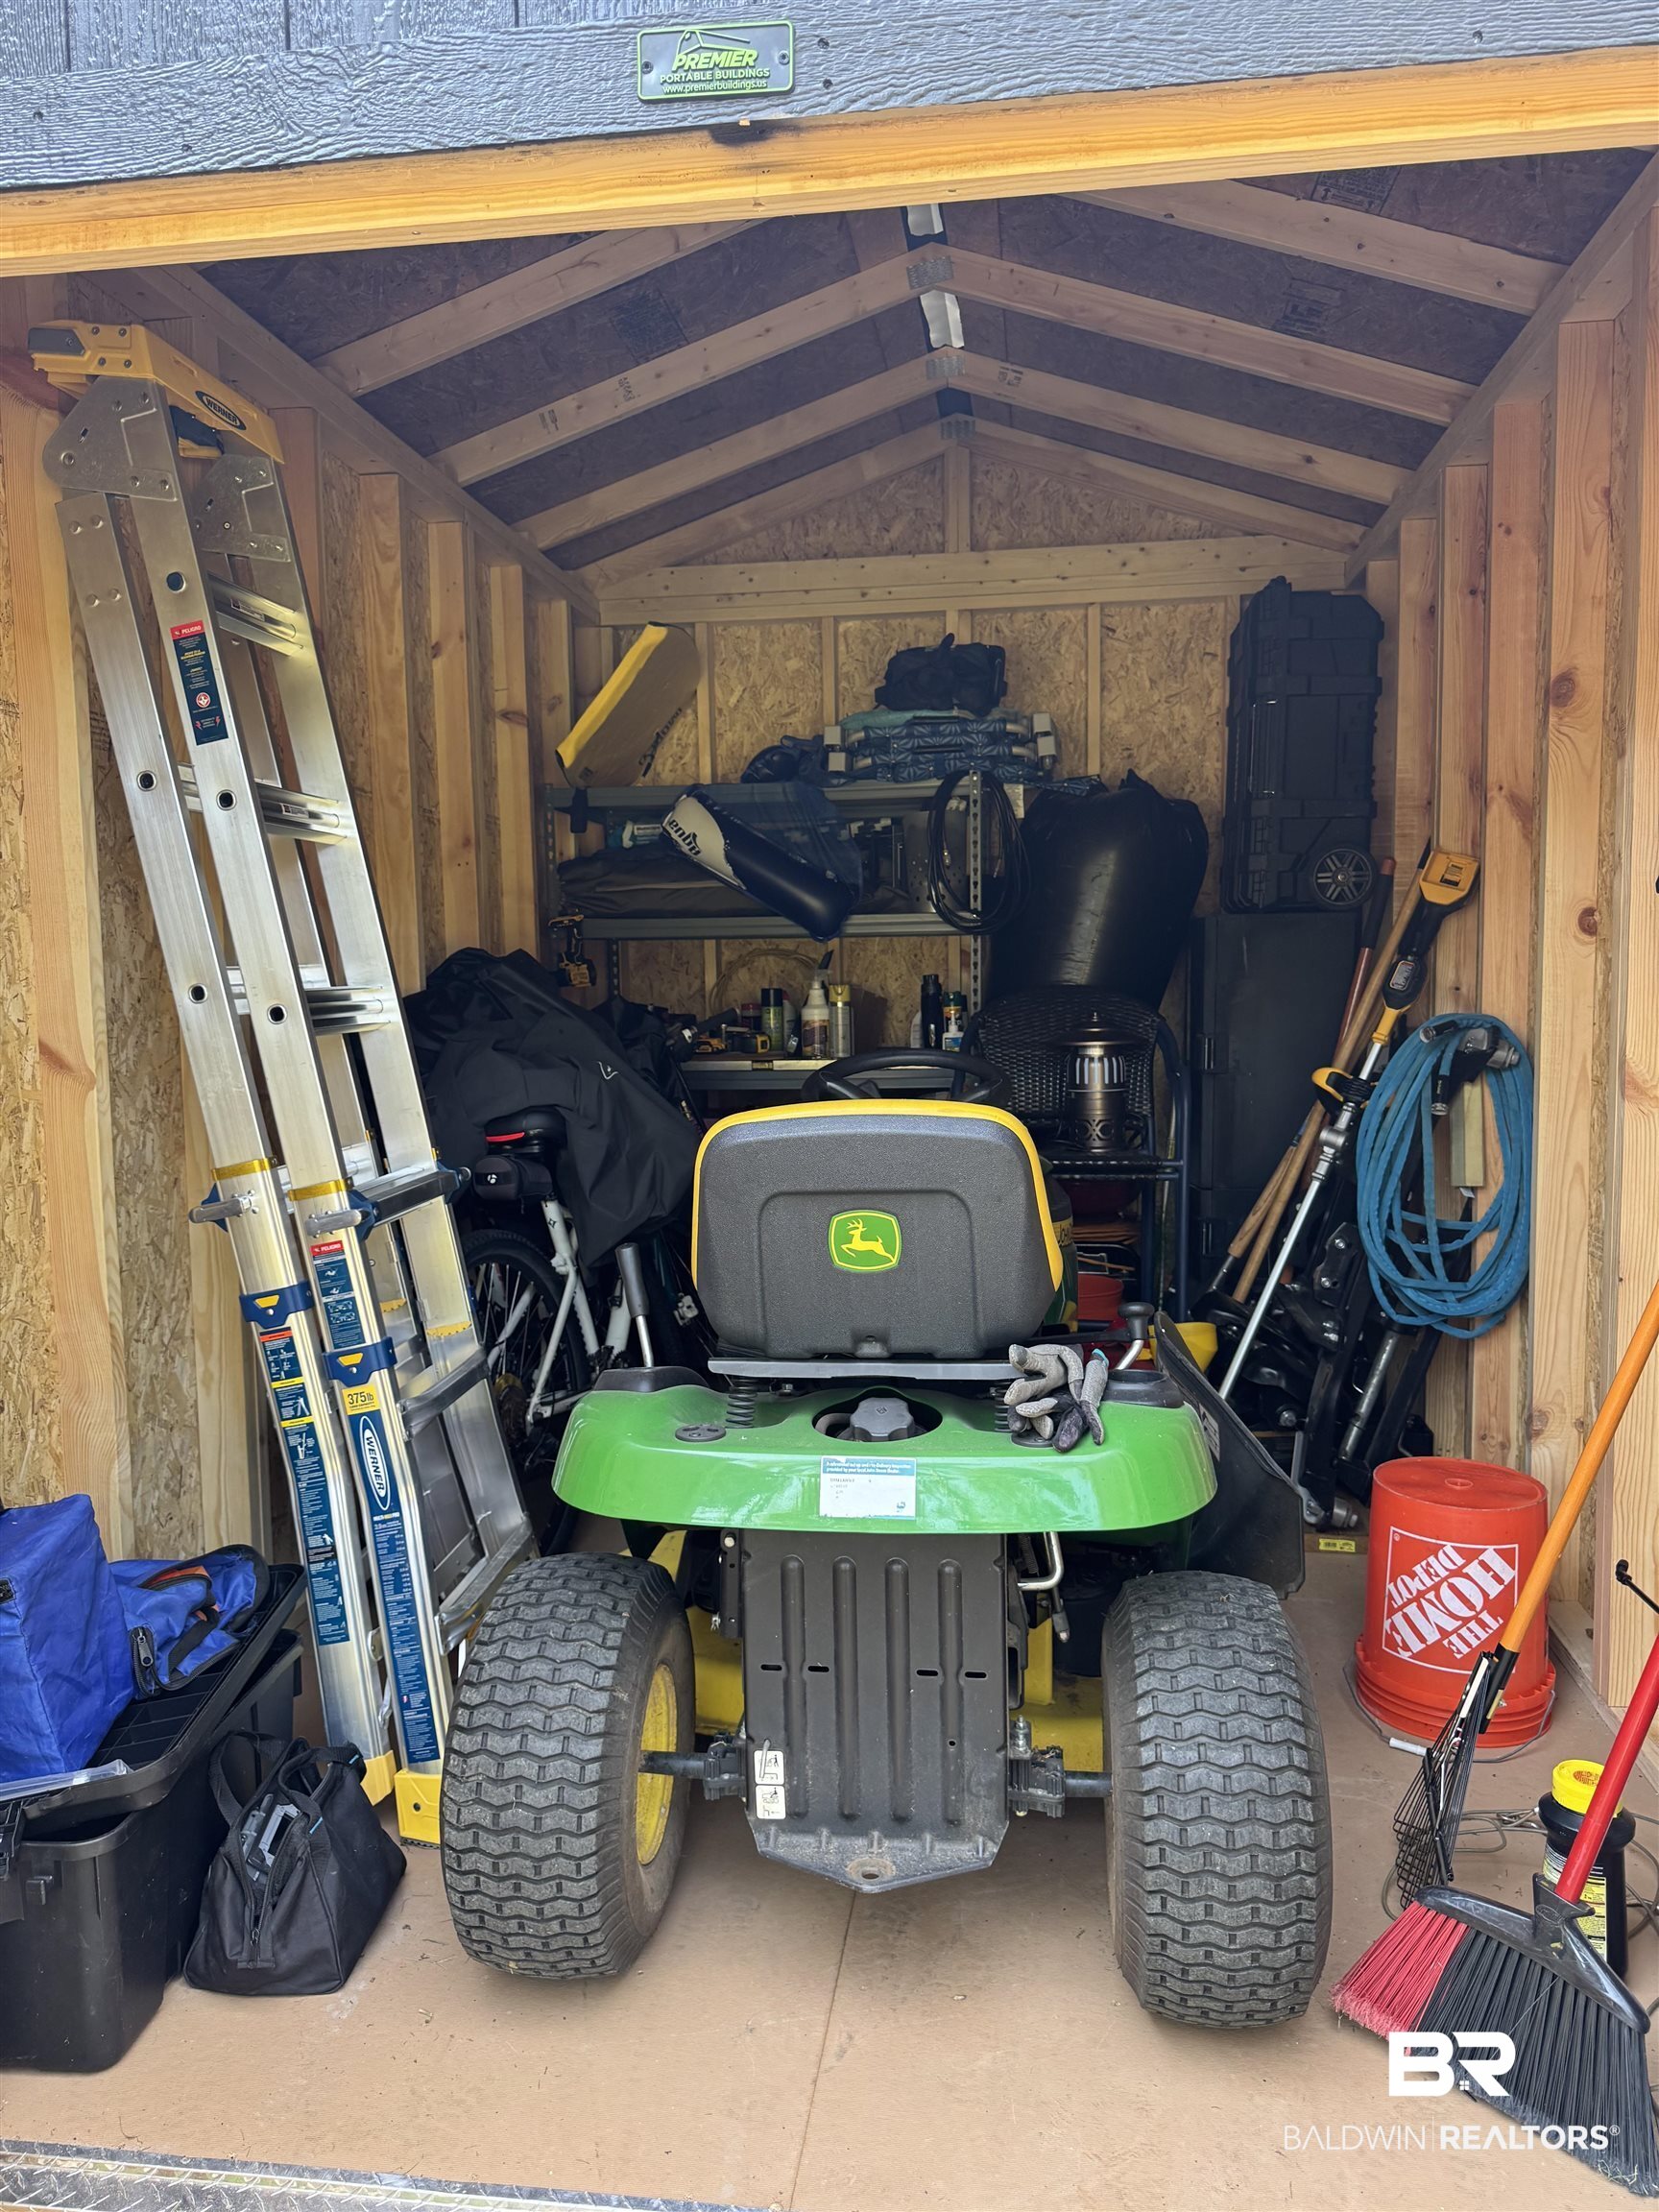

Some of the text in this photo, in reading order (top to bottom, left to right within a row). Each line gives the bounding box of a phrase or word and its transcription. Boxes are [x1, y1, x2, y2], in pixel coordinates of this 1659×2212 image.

[672, 50, 758, 72] PREMIER
[661, 68, 771, 84] PORTABLE BUILDINGS
[662, 81, 766, 93] www.premierbuildings.us
[205, 397, 238, 424] WERNER
[180, 625, 202, 635] PELIGRO
[365, 1435, 385, 1492] WERNER
[1387, 1544, 1466, 1608] DEPOT
[1384, 1547, 1516, 1659] HOME
[1442, 1610, 1504, 1659] THE
